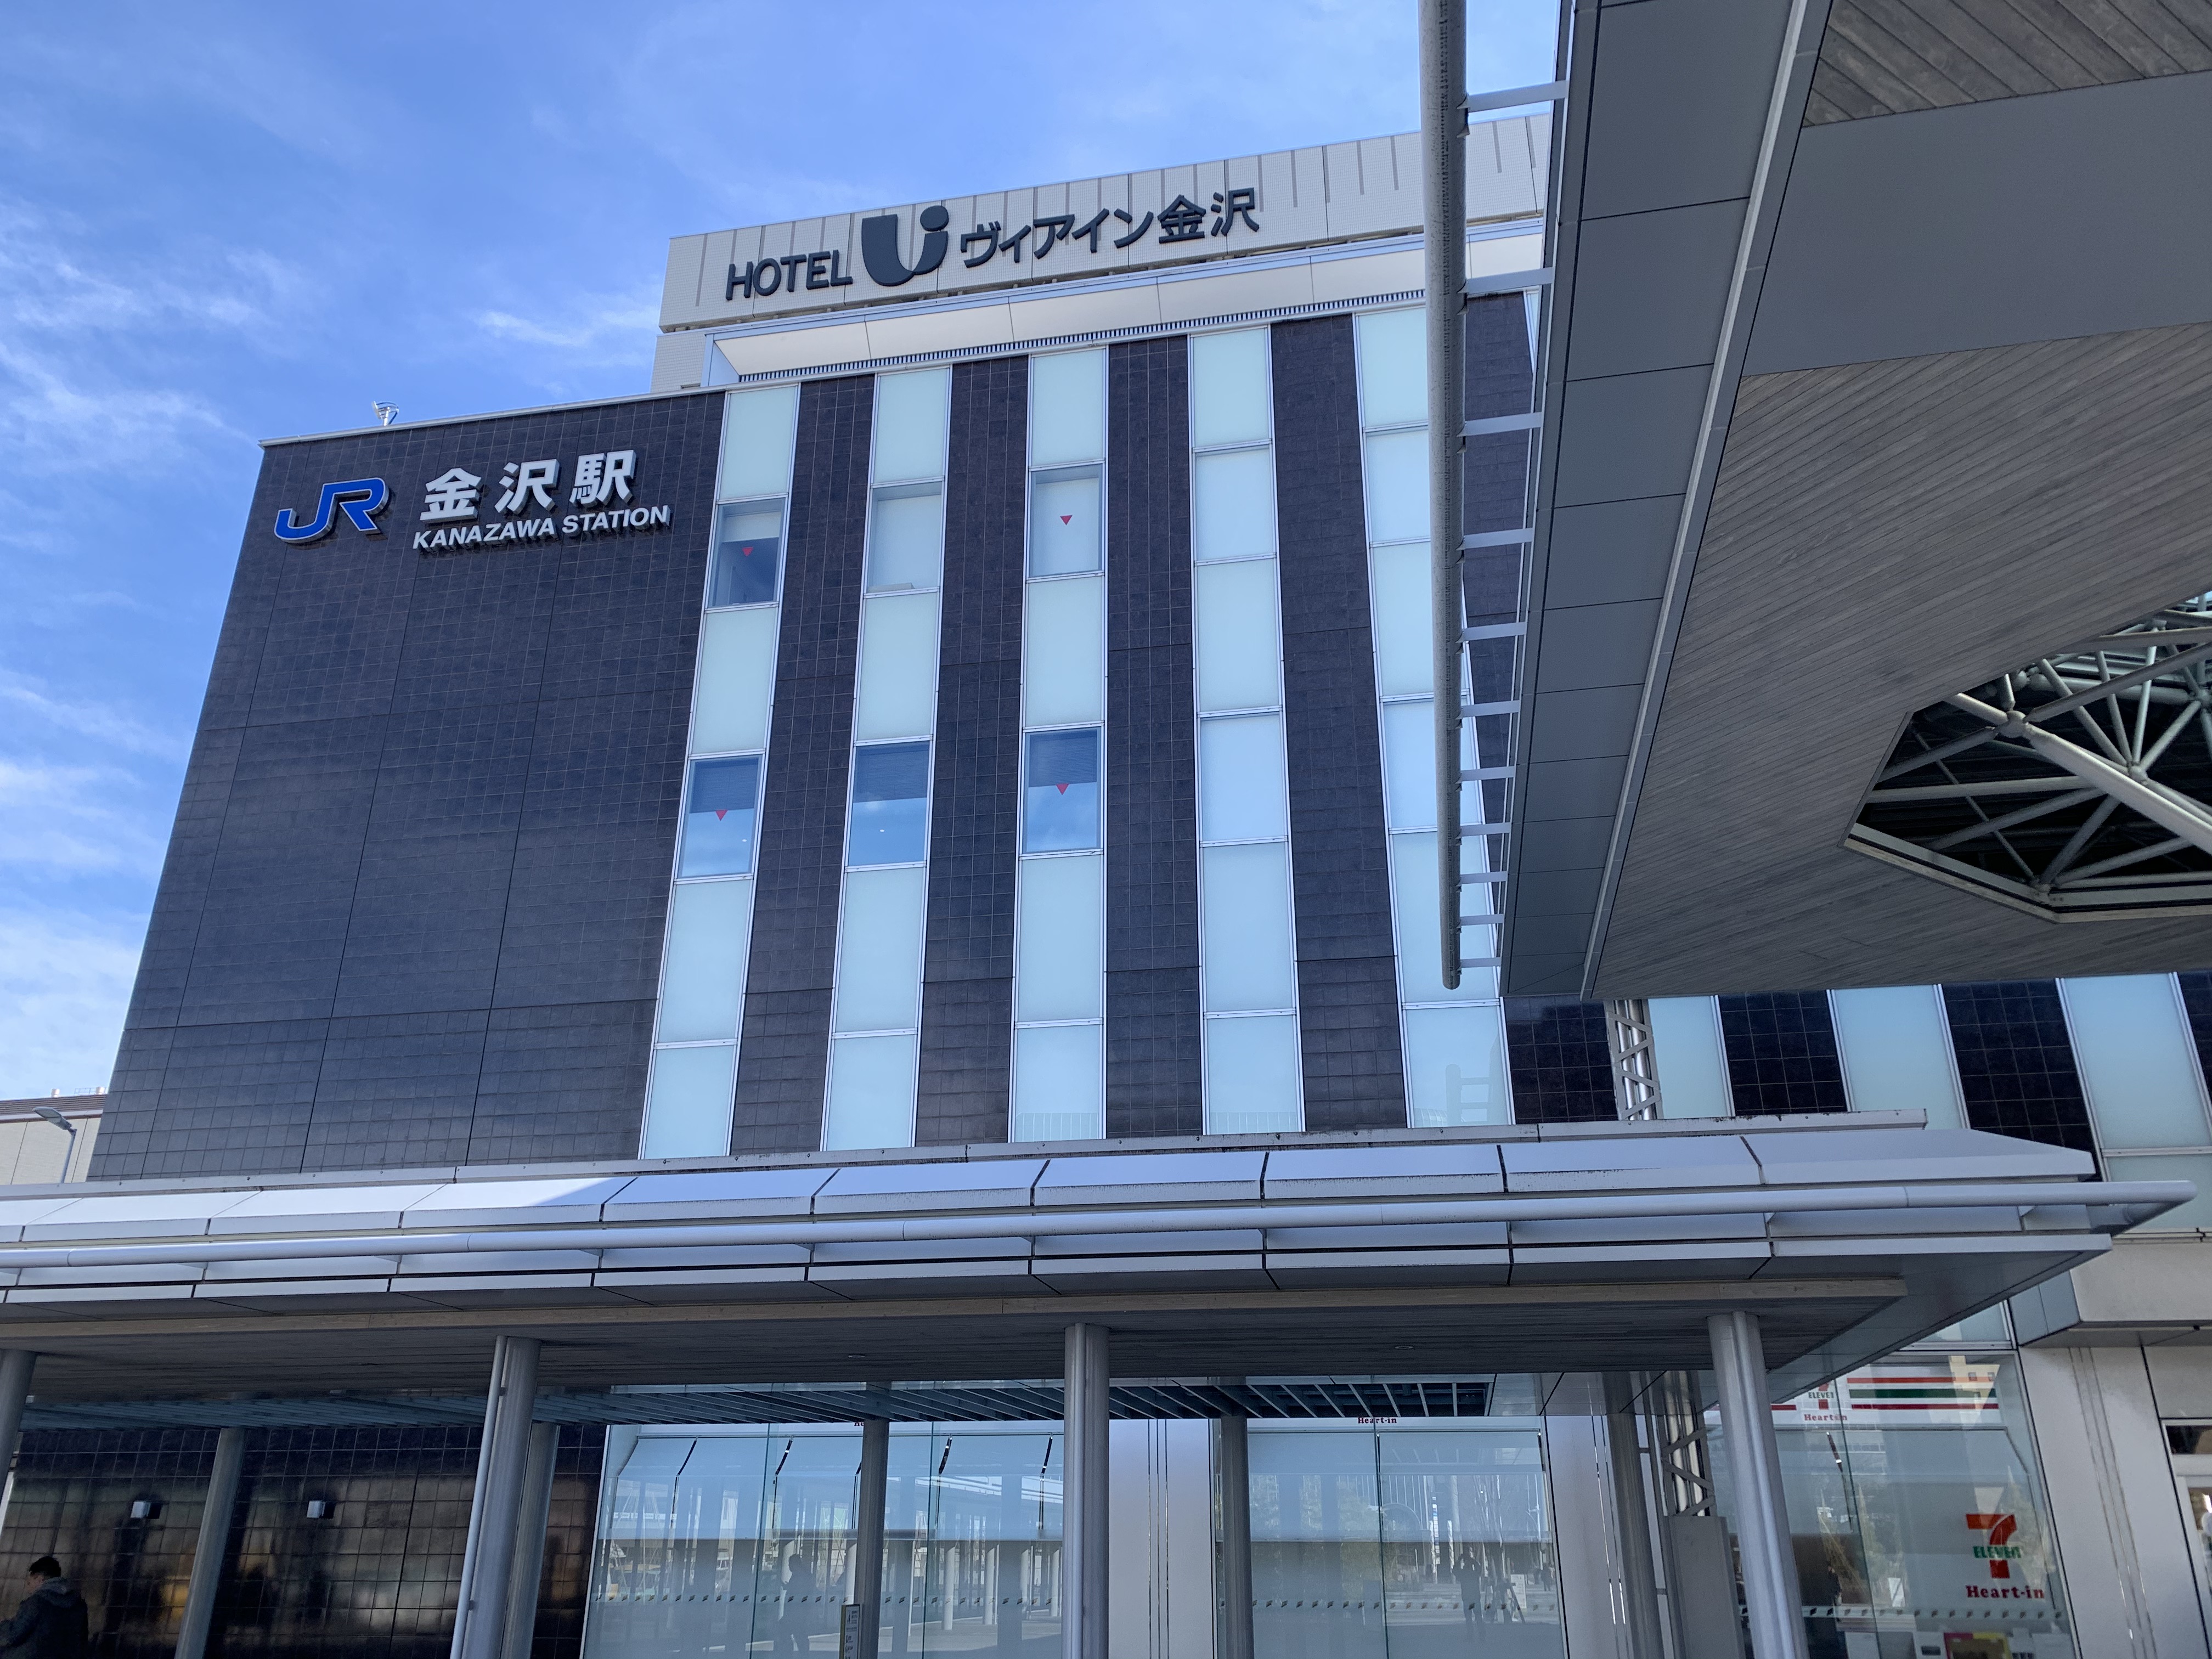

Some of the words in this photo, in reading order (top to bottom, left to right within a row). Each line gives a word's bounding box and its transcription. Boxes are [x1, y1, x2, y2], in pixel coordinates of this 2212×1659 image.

[726, 250, 853, 301] HOTEL
[961, 188, 1260, 268] ヴィアイン金沢
[274, 477, 387, 541] JR
[420, 450, 636, 522] 金沢駅
[413, 518, 556, 549] KANAZAWA
[562, 505, 670, 534] STATION
[1966, 1514, 2017, 1579] 7
[1966, 1585, 2045, 1599] Heart-in
